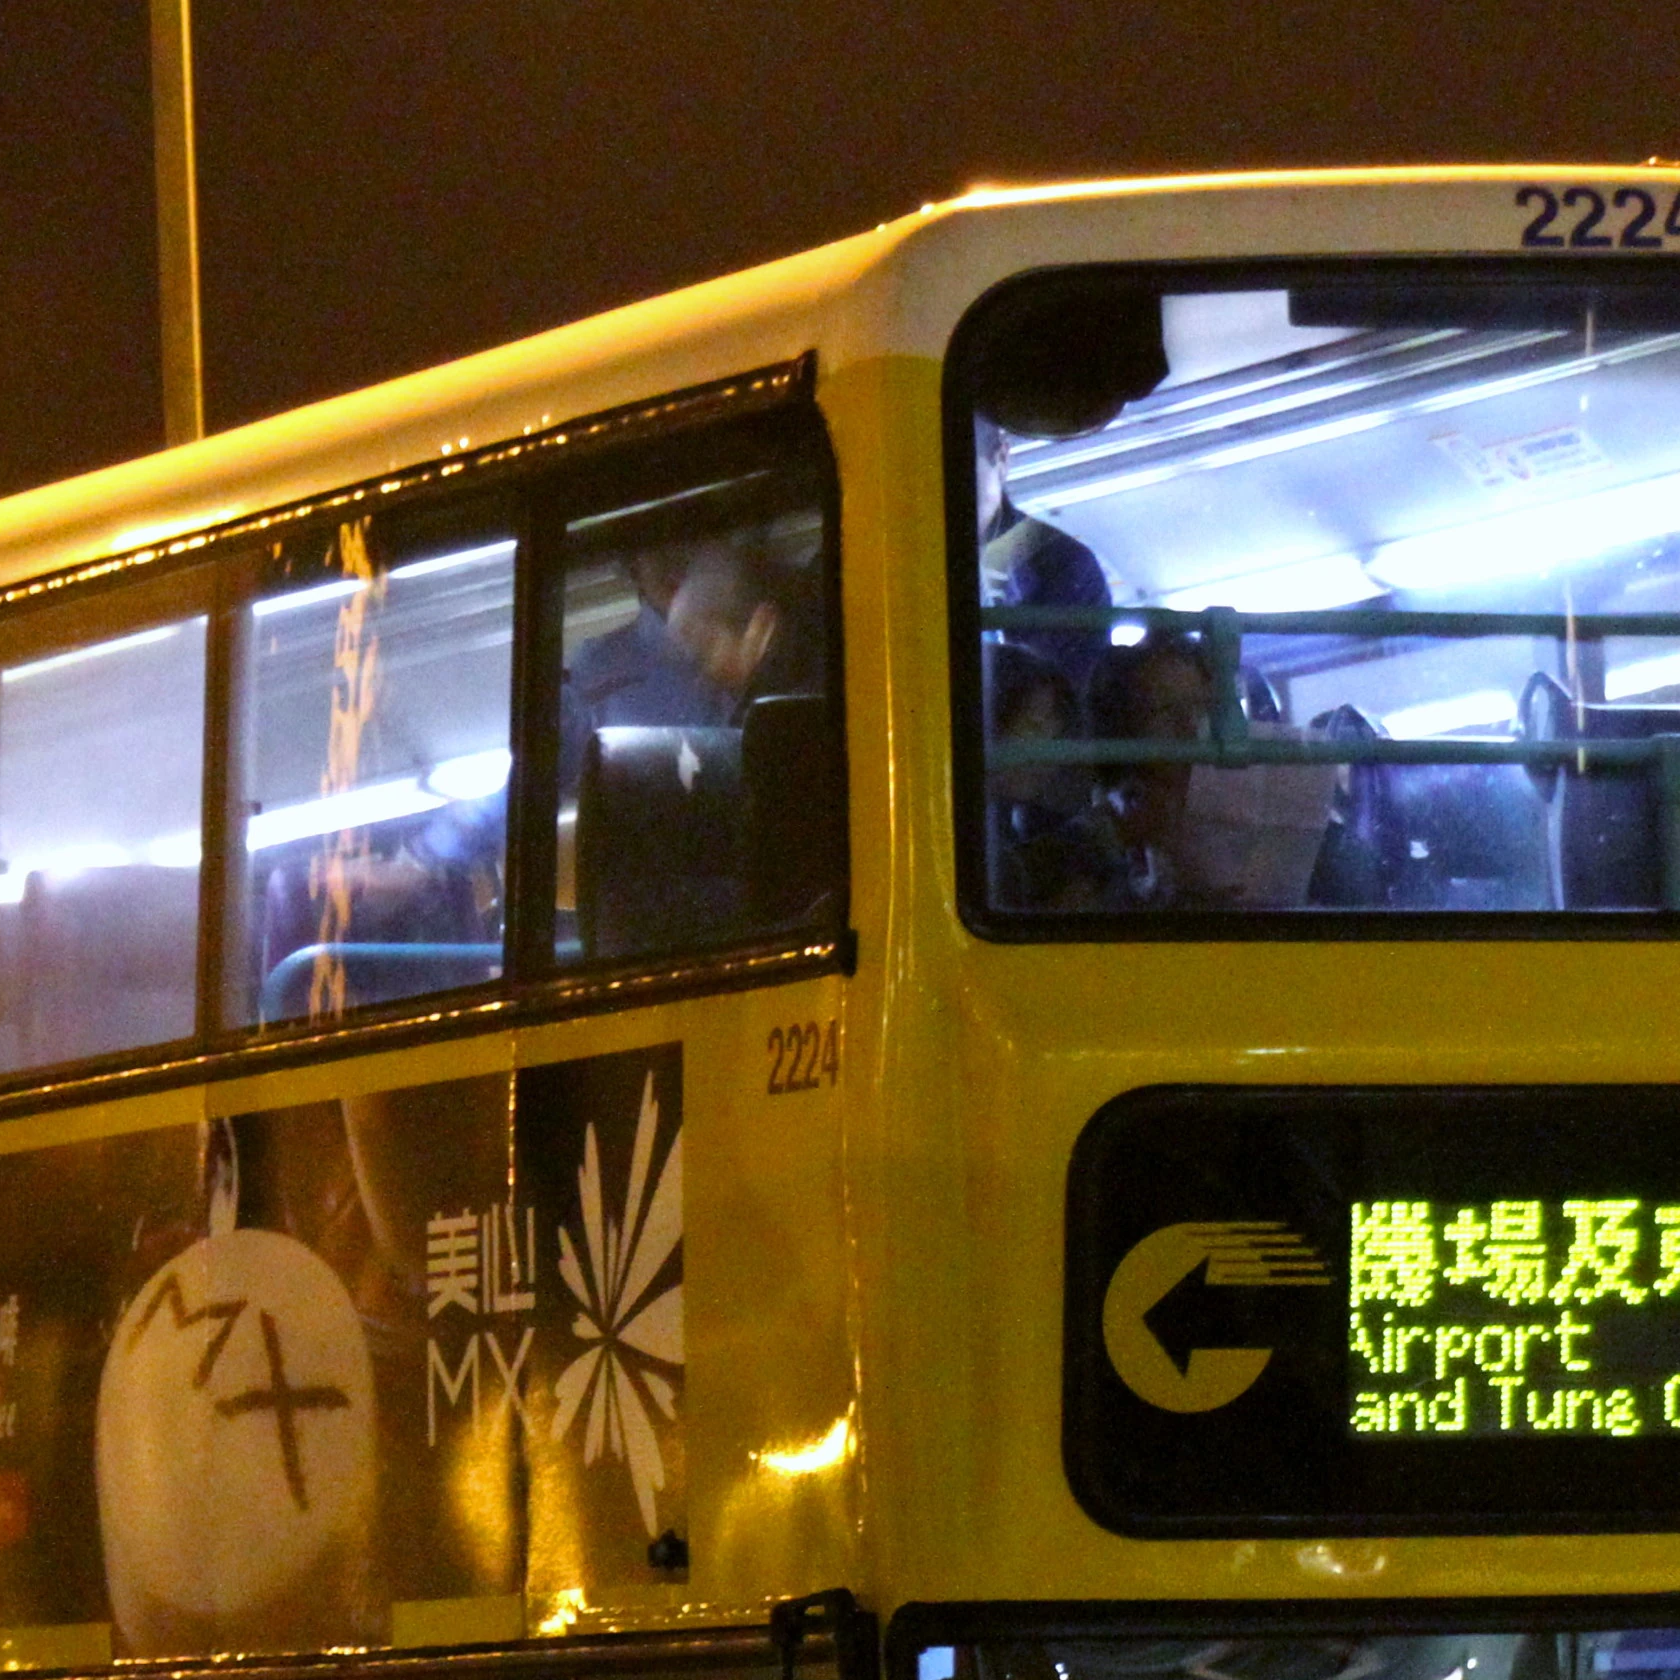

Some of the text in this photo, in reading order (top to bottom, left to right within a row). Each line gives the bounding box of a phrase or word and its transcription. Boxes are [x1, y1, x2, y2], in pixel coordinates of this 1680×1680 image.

[767, 1018, 839, 1095] 2224
[1350, 1311, 1591, 1380] Airport
[427, 1327, 537, 1447] MX
[1350, 1377, 1465, 1432] and
[1488, 1376, 1641, 1438] Tung
